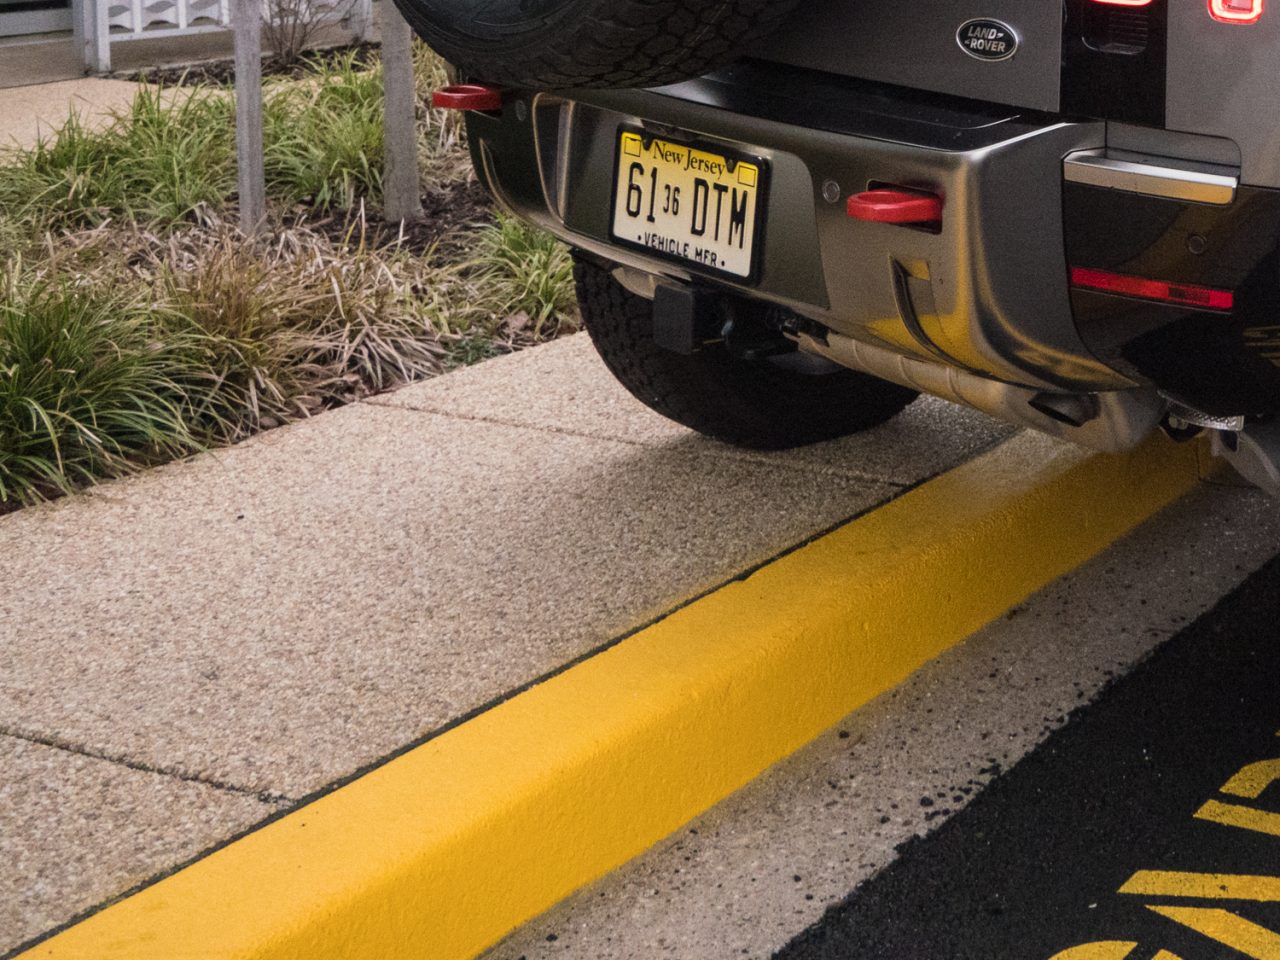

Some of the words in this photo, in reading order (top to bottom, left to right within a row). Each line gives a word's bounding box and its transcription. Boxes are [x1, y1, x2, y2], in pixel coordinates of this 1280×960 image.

[967, 26, 998, 40] LAND
[969, 39, 1006, 53] ROVER
[653, 141, 684, 164] New
[683, 149, 726, 181] Jersey
[690, 177, 748, 250] DTM
[644, 231, 690, 258] VEHICLE
[694, 246, 718, 267] MFR
